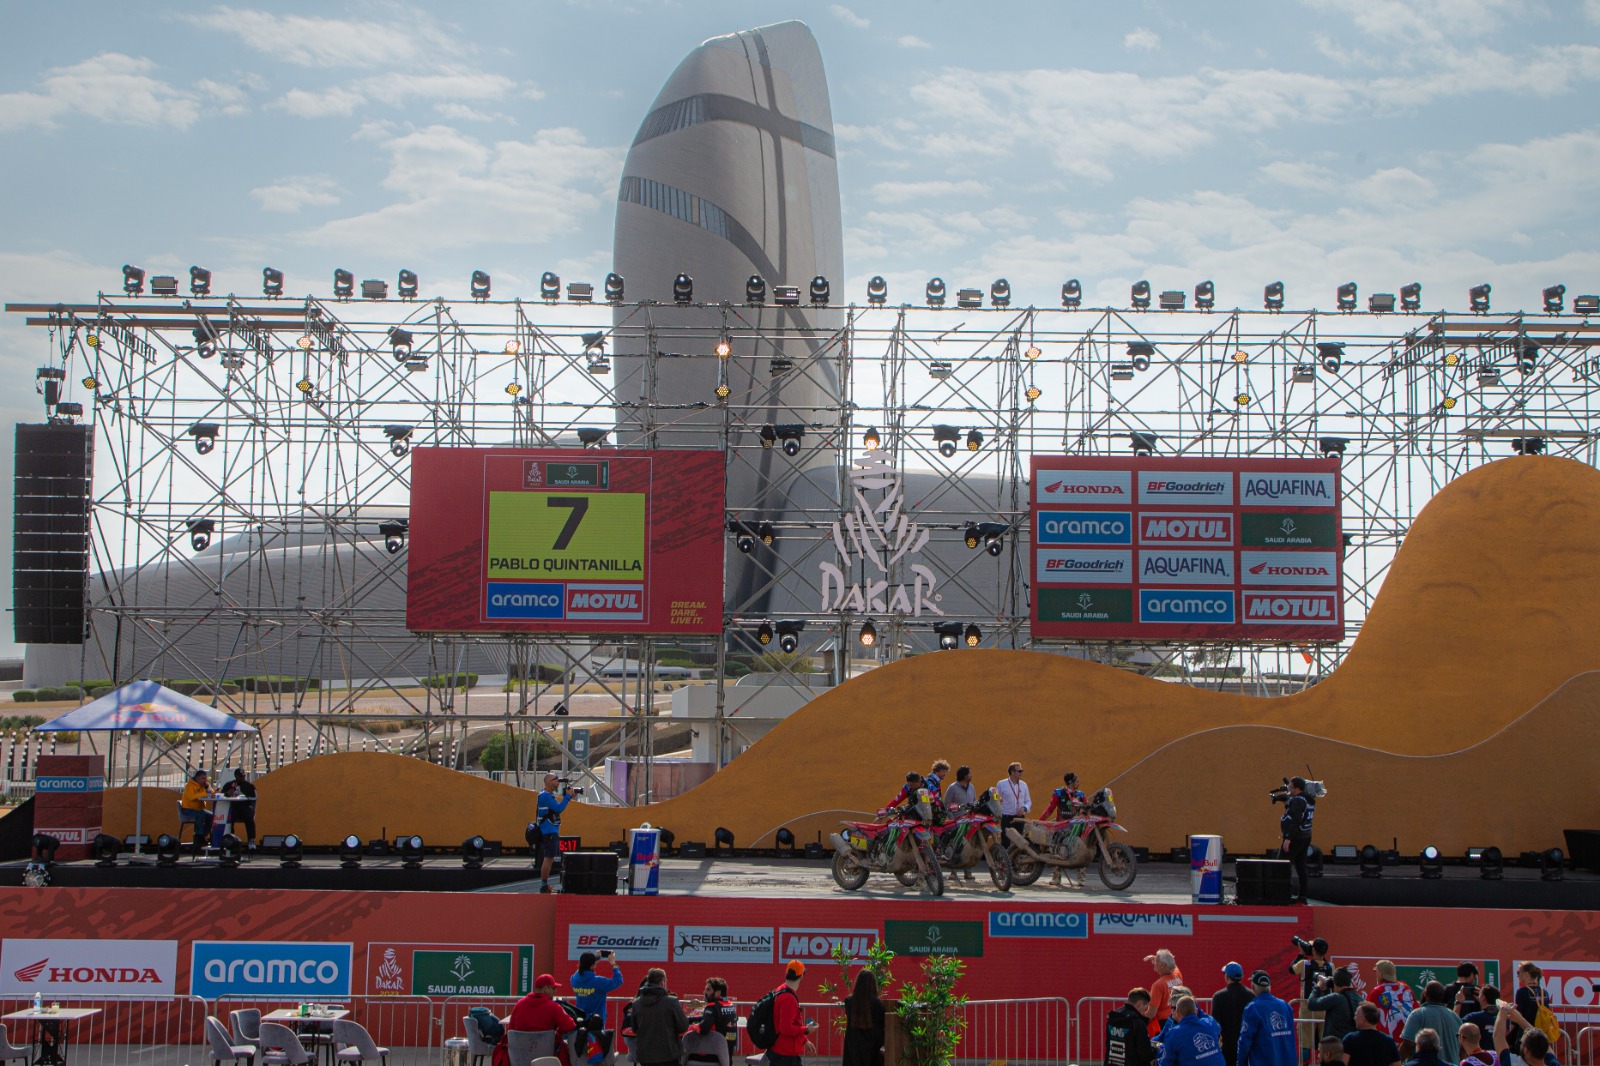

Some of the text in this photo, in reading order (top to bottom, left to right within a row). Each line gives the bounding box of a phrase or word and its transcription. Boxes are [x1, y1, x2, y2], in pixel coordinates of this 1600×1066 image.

[1063, 485, 1124, 494] HONDA
[1147, 482, 1224, 492] BFGoodrich
[1246, 479, 1327, 498] AQUAFINA
[547, 496, 589, 550] 7
[1046, 520, 1124, 535] aramco
[1146, 520, 1227, 538] MOTUL
[490, 558, 642, 572] PABLO QUINTANILLA
[1046, 559, 1123, 570] BFGoodrich
[1144, 557, 1226, 576] AQUAFINA
[1267, 566, 1330, 576] HONDA
[819, 561, 944, 617] DAKAR
[491, 592, 560, 608] aramco
[571, 593, 638, 609] MOTUL
[1148, 599, 1227, 614] aramco
[1249, 598, 1331, 616] MOTUL
[110, 713, 186, 723] Red Bull
[40, 780, 84, 788] aramco
[998, 913, 1080, 928] aramco
[1099, 914, 1183, 927] AQUAFINA
[578, 936, 660, 946] BFGoodrich
[692, 935, 771, 946] REBELLION
[786, 936, 869, 956] MOTUL
[48, 968, 162, 983] HONDA
[204, 958, 338, 984] aramco
[376, 976, 404, 990] DAKAR
[428, 985, 495, 994] SAUDI ARABIA
